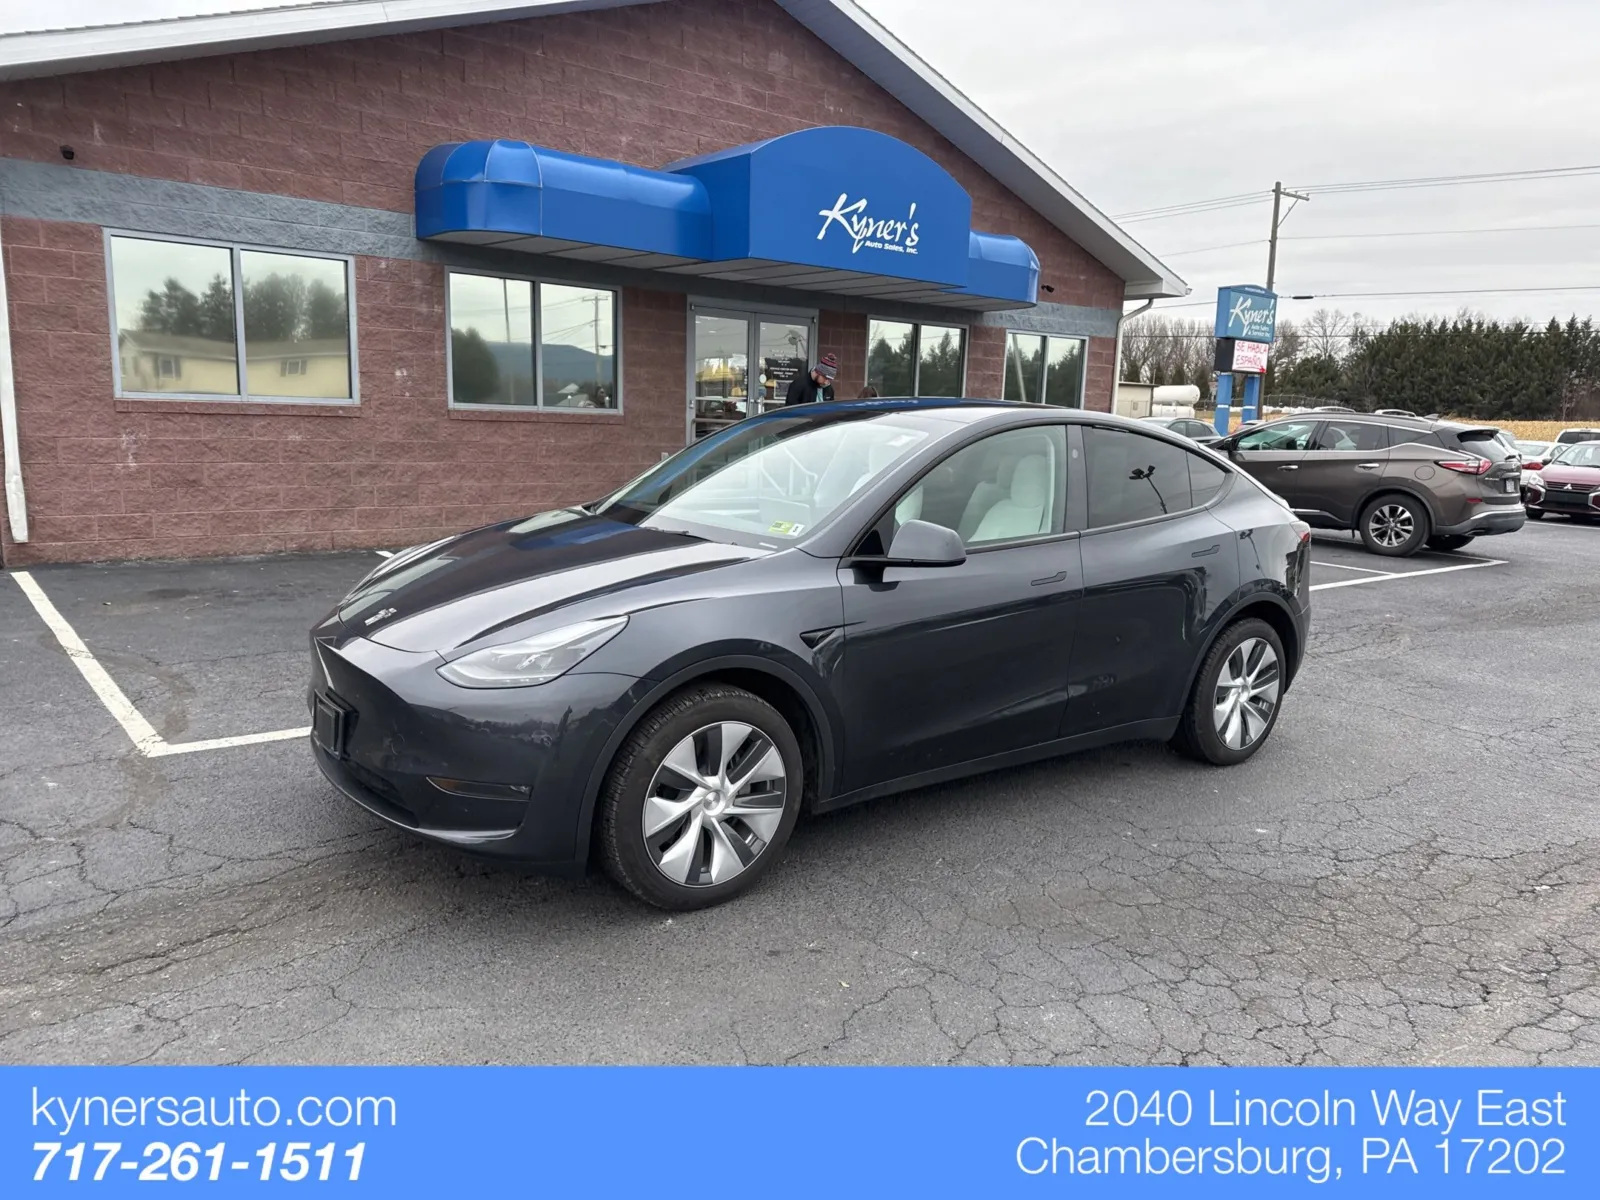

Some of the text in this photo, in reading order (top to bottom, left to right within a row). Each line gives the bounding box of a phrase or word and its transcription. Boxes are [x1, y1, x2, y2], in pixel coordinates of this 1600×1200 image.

[817, 193, 920, 254] Kyner's
[865, 240, 919, 255] Auto Sales, Inc.
[1228, 296, 1275, 337] Kyner's
[1236, 341, 1268, 354] SE HABLA
